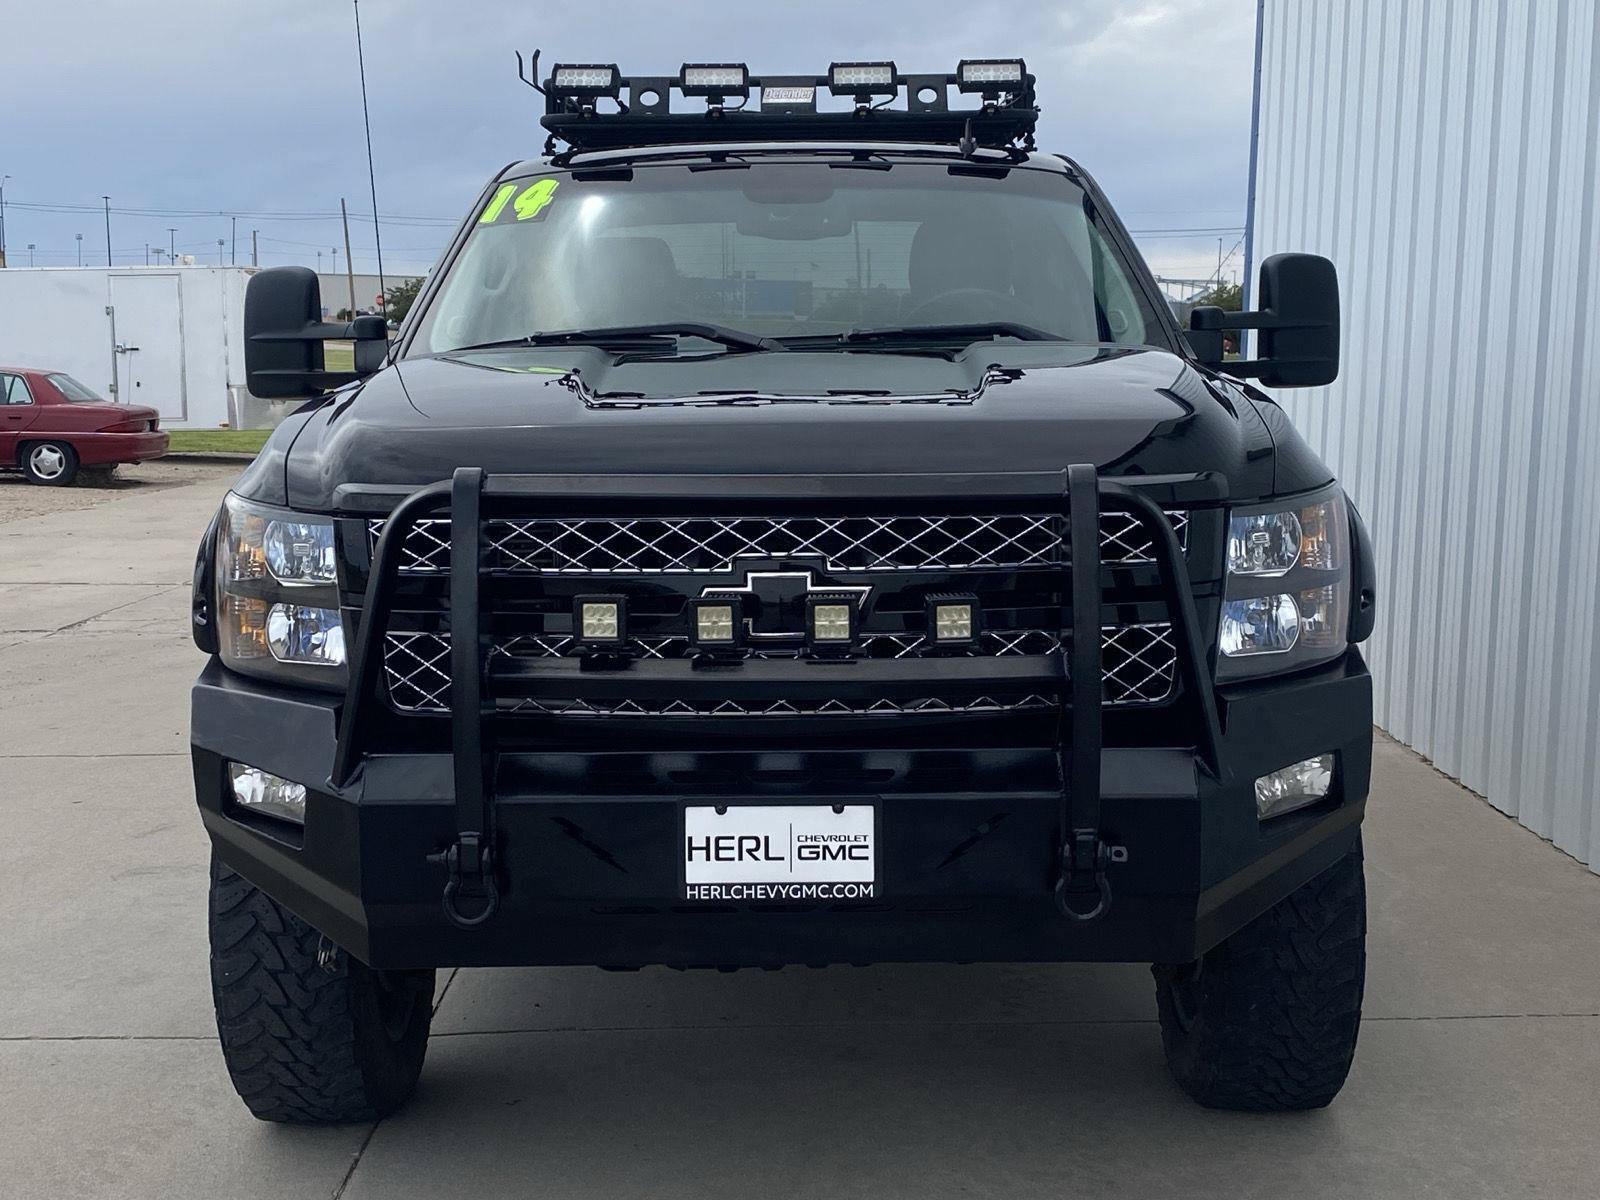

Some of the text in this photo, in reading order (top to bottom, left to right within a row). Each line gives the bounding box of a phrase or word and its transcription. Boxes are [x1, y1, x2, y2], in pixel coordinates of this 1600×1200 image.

[764, 88, 813, 99] Defender
[480, 179, 559, 223] 14
[797, 834, 869, 843] CHEVROLET
[687, 835, 785, 861] HERL
[797, 844, 869, 860] GMC
[686, 884, 874, 899] HERLCHEVYGMC.COM
